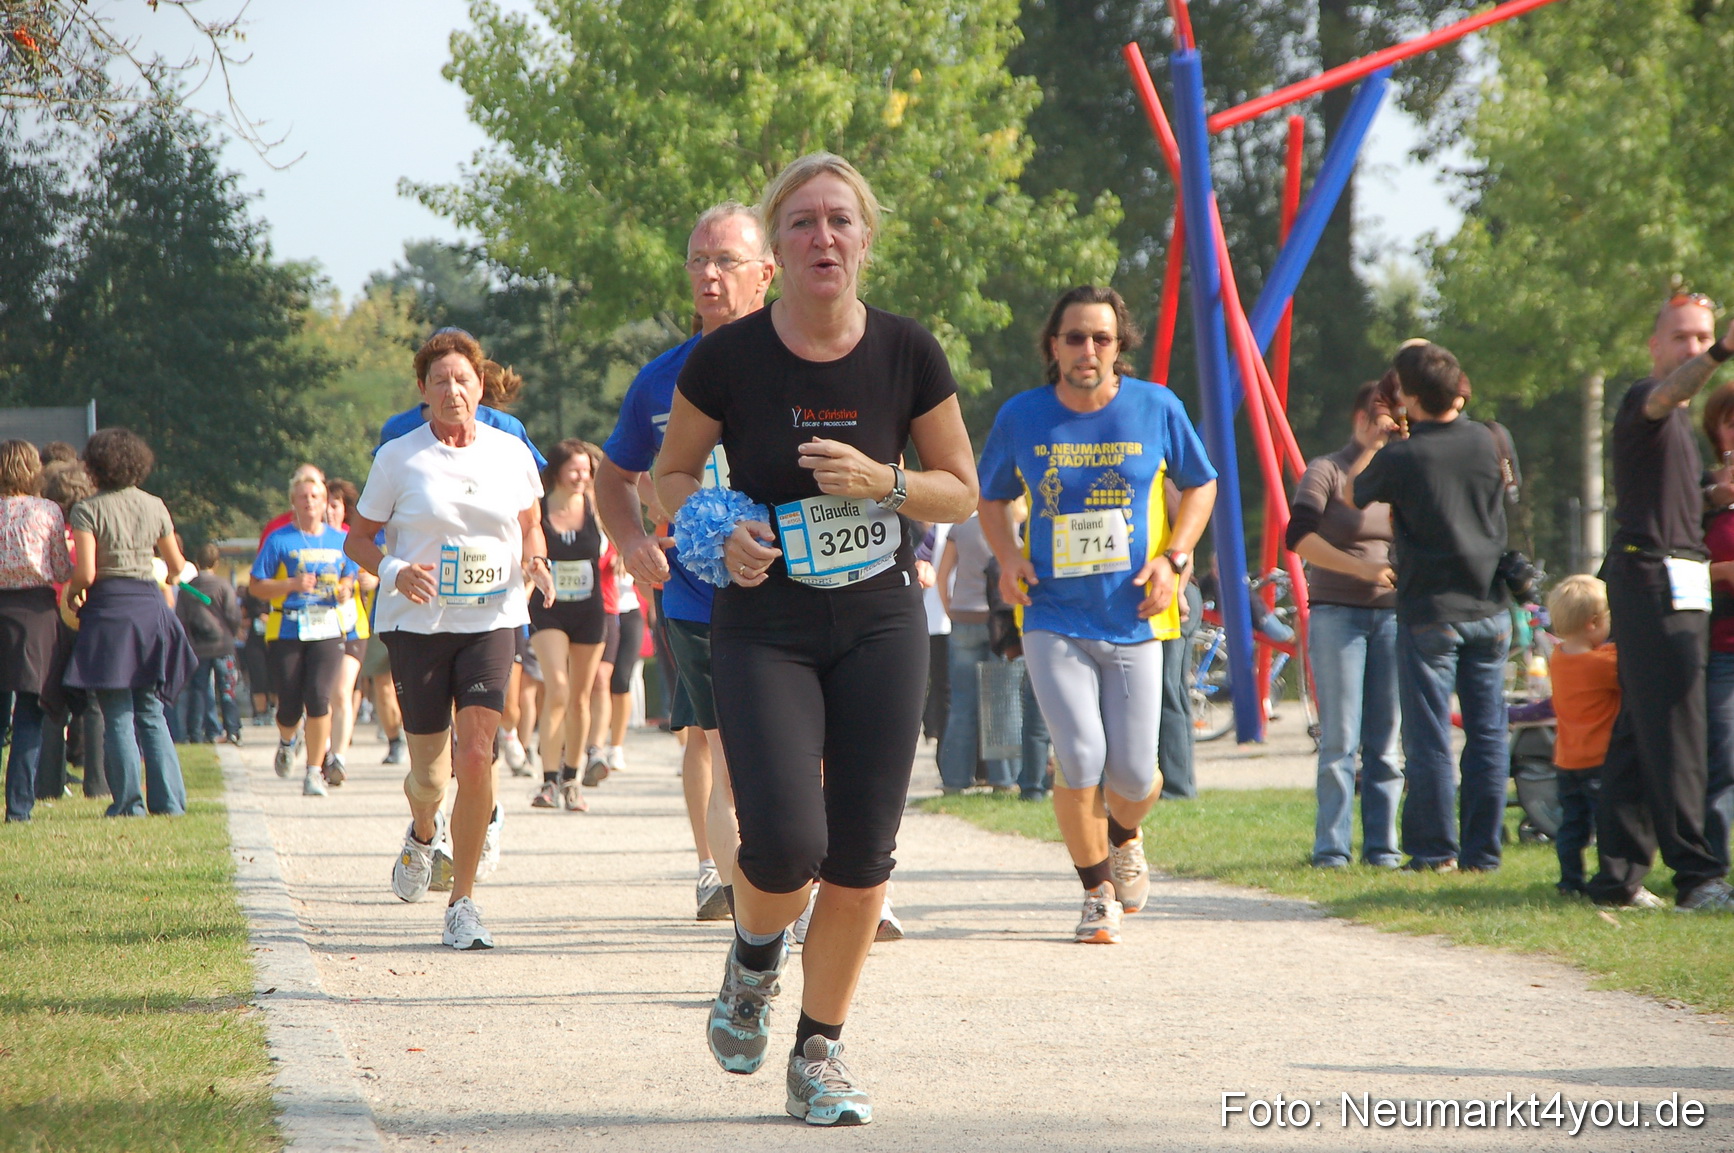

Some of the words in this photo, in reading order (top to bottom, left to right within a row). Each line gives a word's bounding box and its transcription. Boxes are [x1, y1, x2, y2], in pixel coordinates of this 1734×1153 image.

[1034, 444, 1050, 456] 10.
[1052, 442, 1142, 455] NEUMARKTER
[1049, 454, 1125, 467] STADTLAUF
[810, 501, 860, 523] Claudia
[1071, 517, 1104, 531] Roland
[818, 521, 887, 556] 3209
[1080, 535, 1116, 554] 714
[463, 551, 486, 562] Irene
[463, 566, 502, 585] 3291
